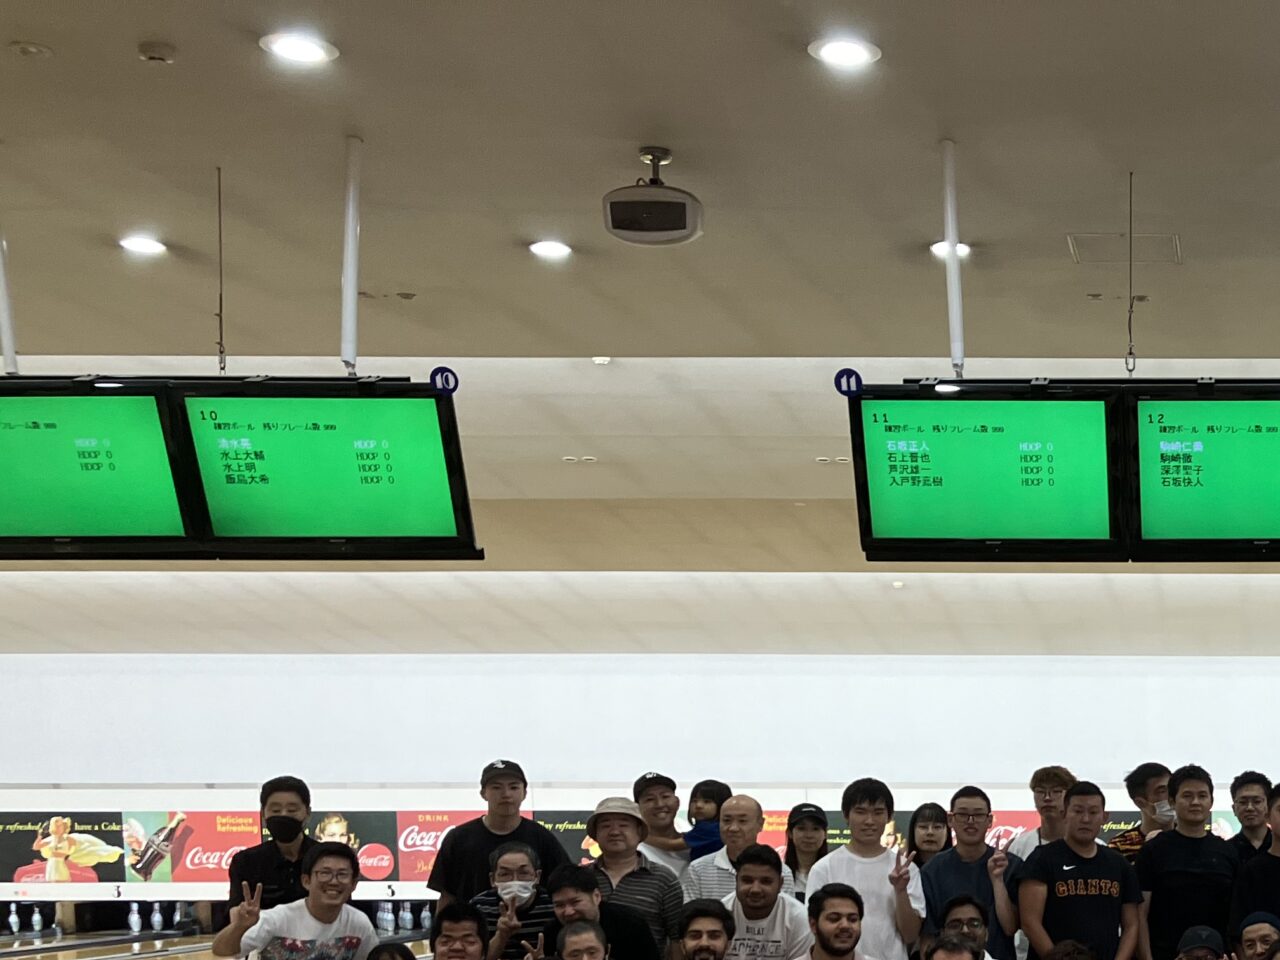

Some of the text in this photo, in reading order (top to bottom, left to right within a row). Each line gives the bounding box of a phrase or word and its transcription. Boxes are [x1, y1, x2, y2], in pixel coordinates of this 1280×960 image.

[435, 372, 455, 389] 10
[841, 374, 857, 391] 11
[200, 410, 218, 421] 10
[872, 413, 889, 423] 11
[1147, 413, 1165, 424] 12
[418, 814, 449, 823] DRINK
[75, 821, 92, 831] have
[555, 821, 587, 832] refreshe
[398, 825, 457, 852] Coca-C
[186, 846, 249, 870] Coca-C
[1056, 879, 1120, 897] GIANTS
